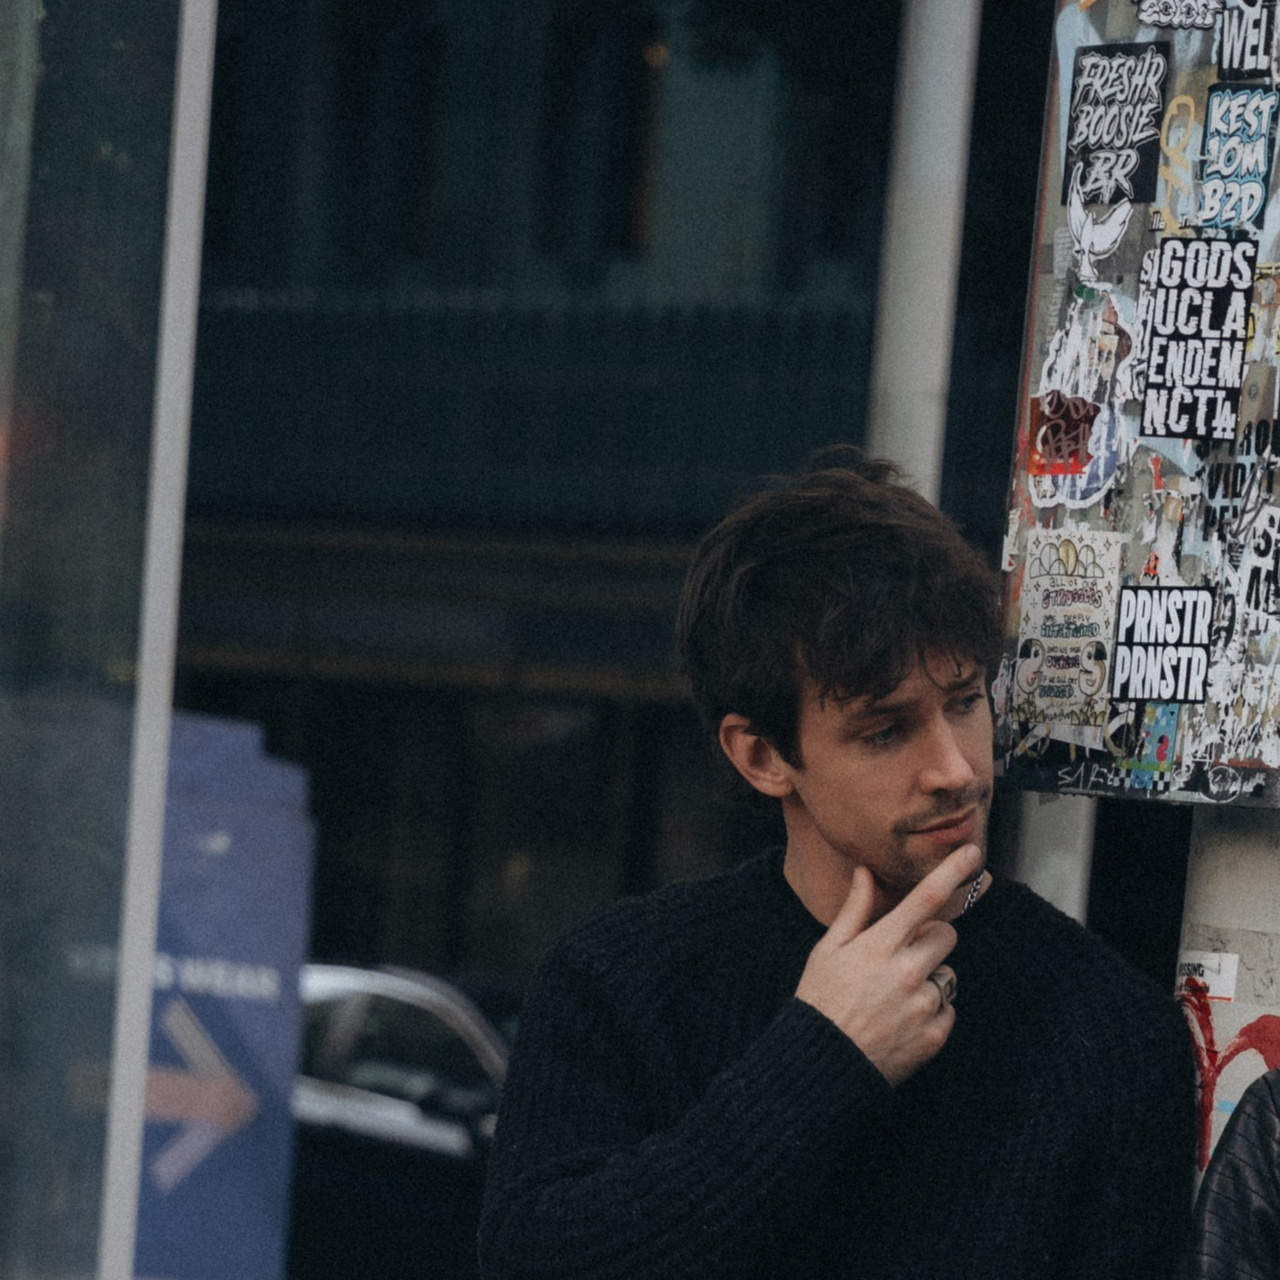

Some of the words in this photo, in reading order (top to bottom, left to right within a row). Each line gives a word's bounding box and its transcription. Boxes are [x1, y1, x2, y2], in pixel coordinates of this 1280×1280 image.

[1073, 46, 1167, 114] FRESHR
[1068, 102, 1162, 152] BOOSIE
[1209, 90, 1279, 136] KEST
[1199, 178, 1267, 225] B2D
[1159, 239, 1257, 289] GODS
[1153, 288, 1246, 338] UCLA
[1149, 337, 1244, 388] ENDEM
[1118, 589, 1213, 645] PRNSTR
[1112, 645, 1208, 700] PRNSTR
